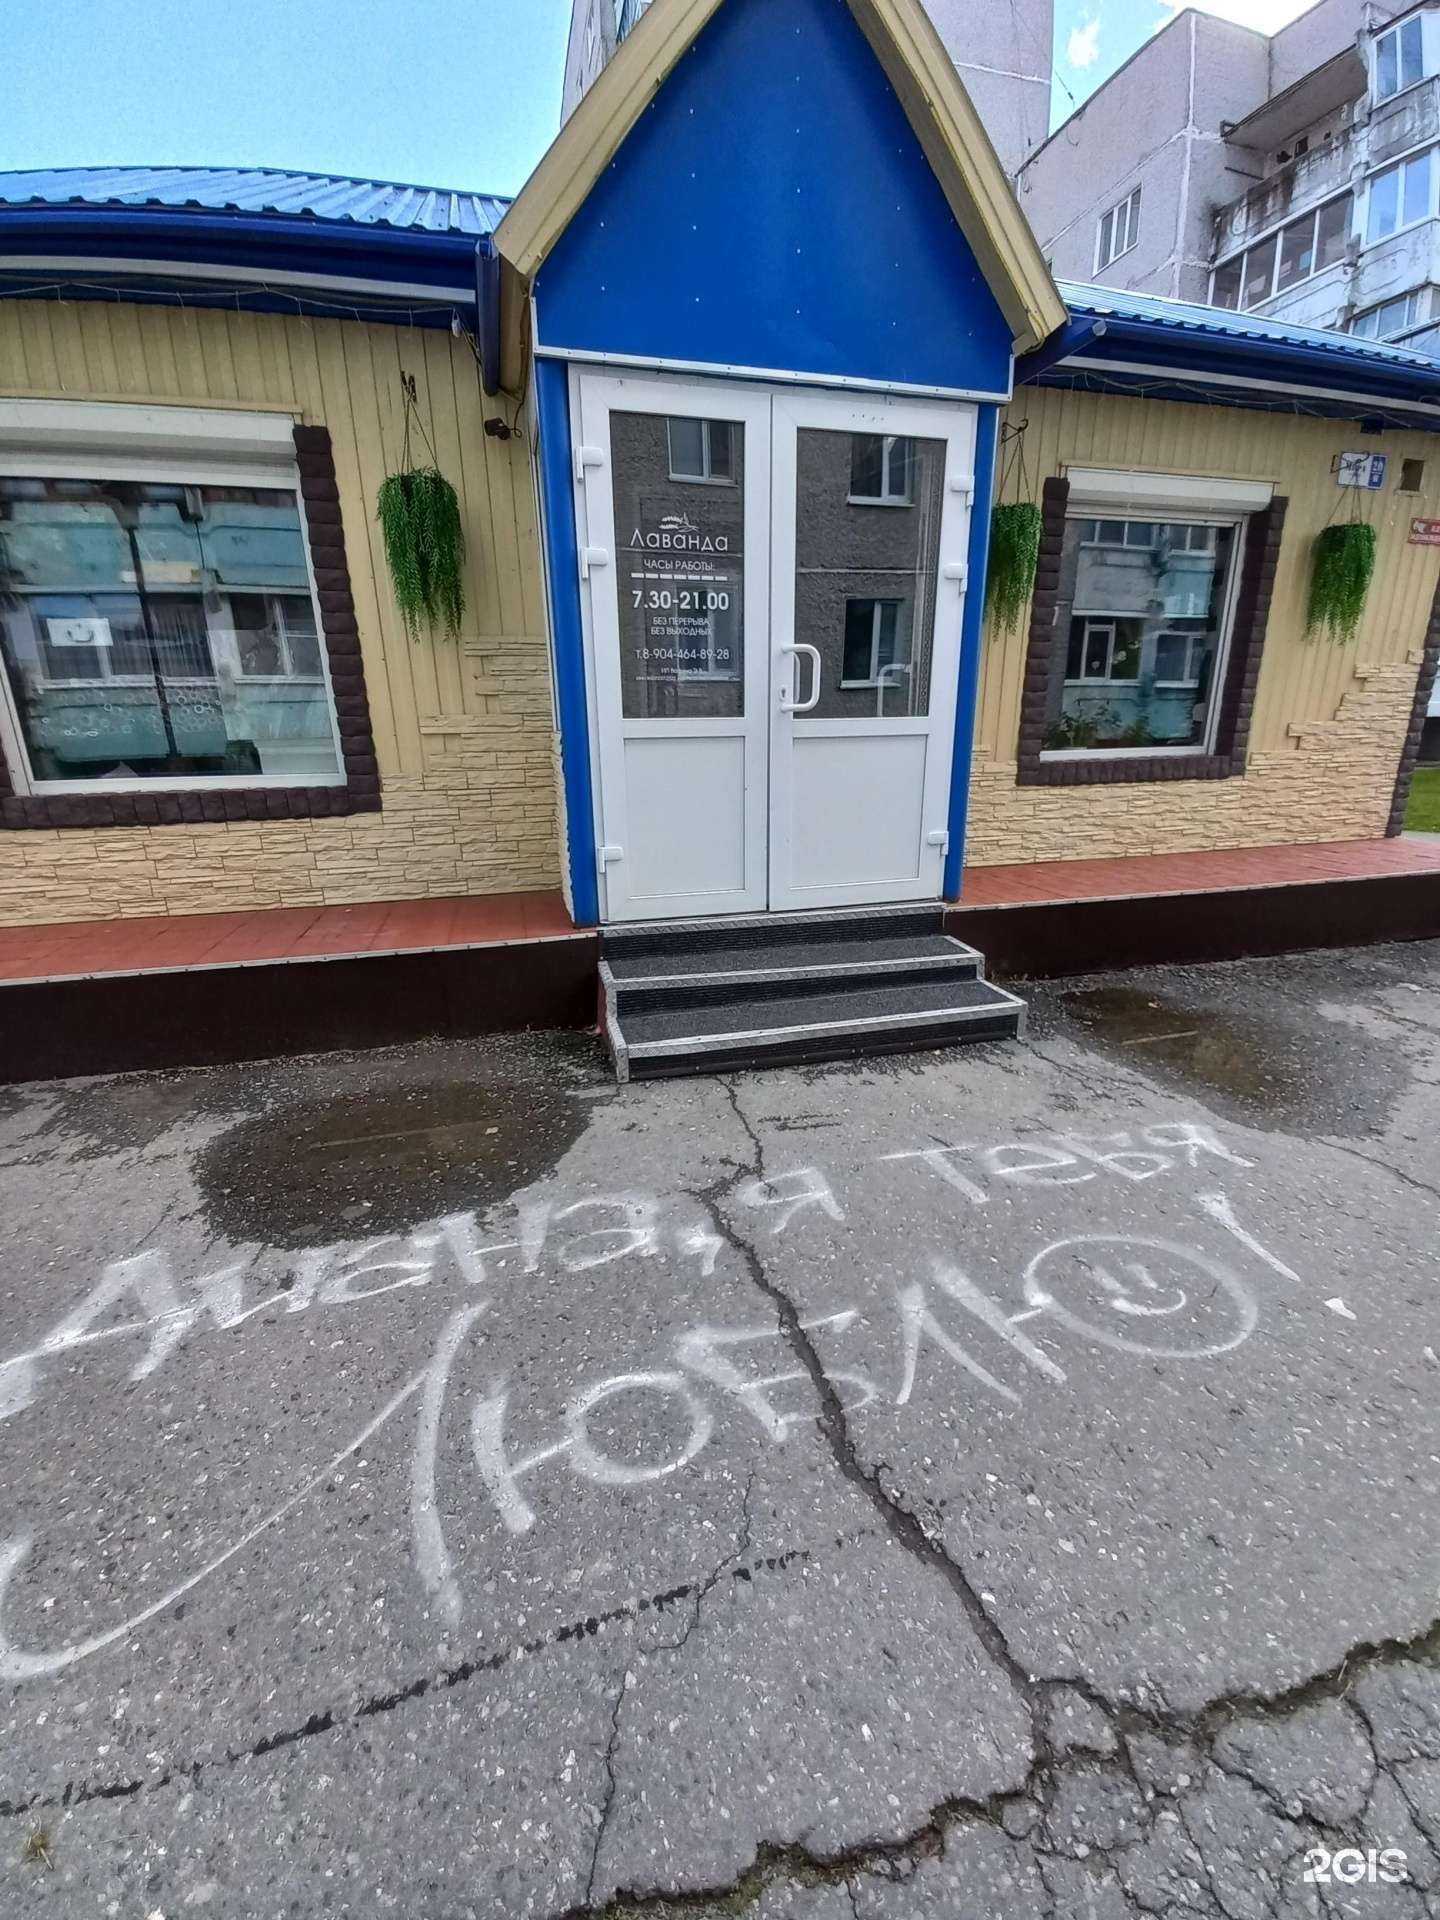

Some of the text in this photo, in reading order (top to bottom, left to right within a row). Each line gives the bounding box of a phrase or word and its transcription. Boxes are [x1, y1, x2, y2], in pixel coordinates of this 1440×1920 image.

[630, 528, 728, 551] Лаванда
[644, 559, 673, 570] ЧАСЫ
[632, 590, 729, 610] 7.30-21.00
[653, 617, 667, 626] БЕЗ
[650, 627, 665, 635] БЕЗ
